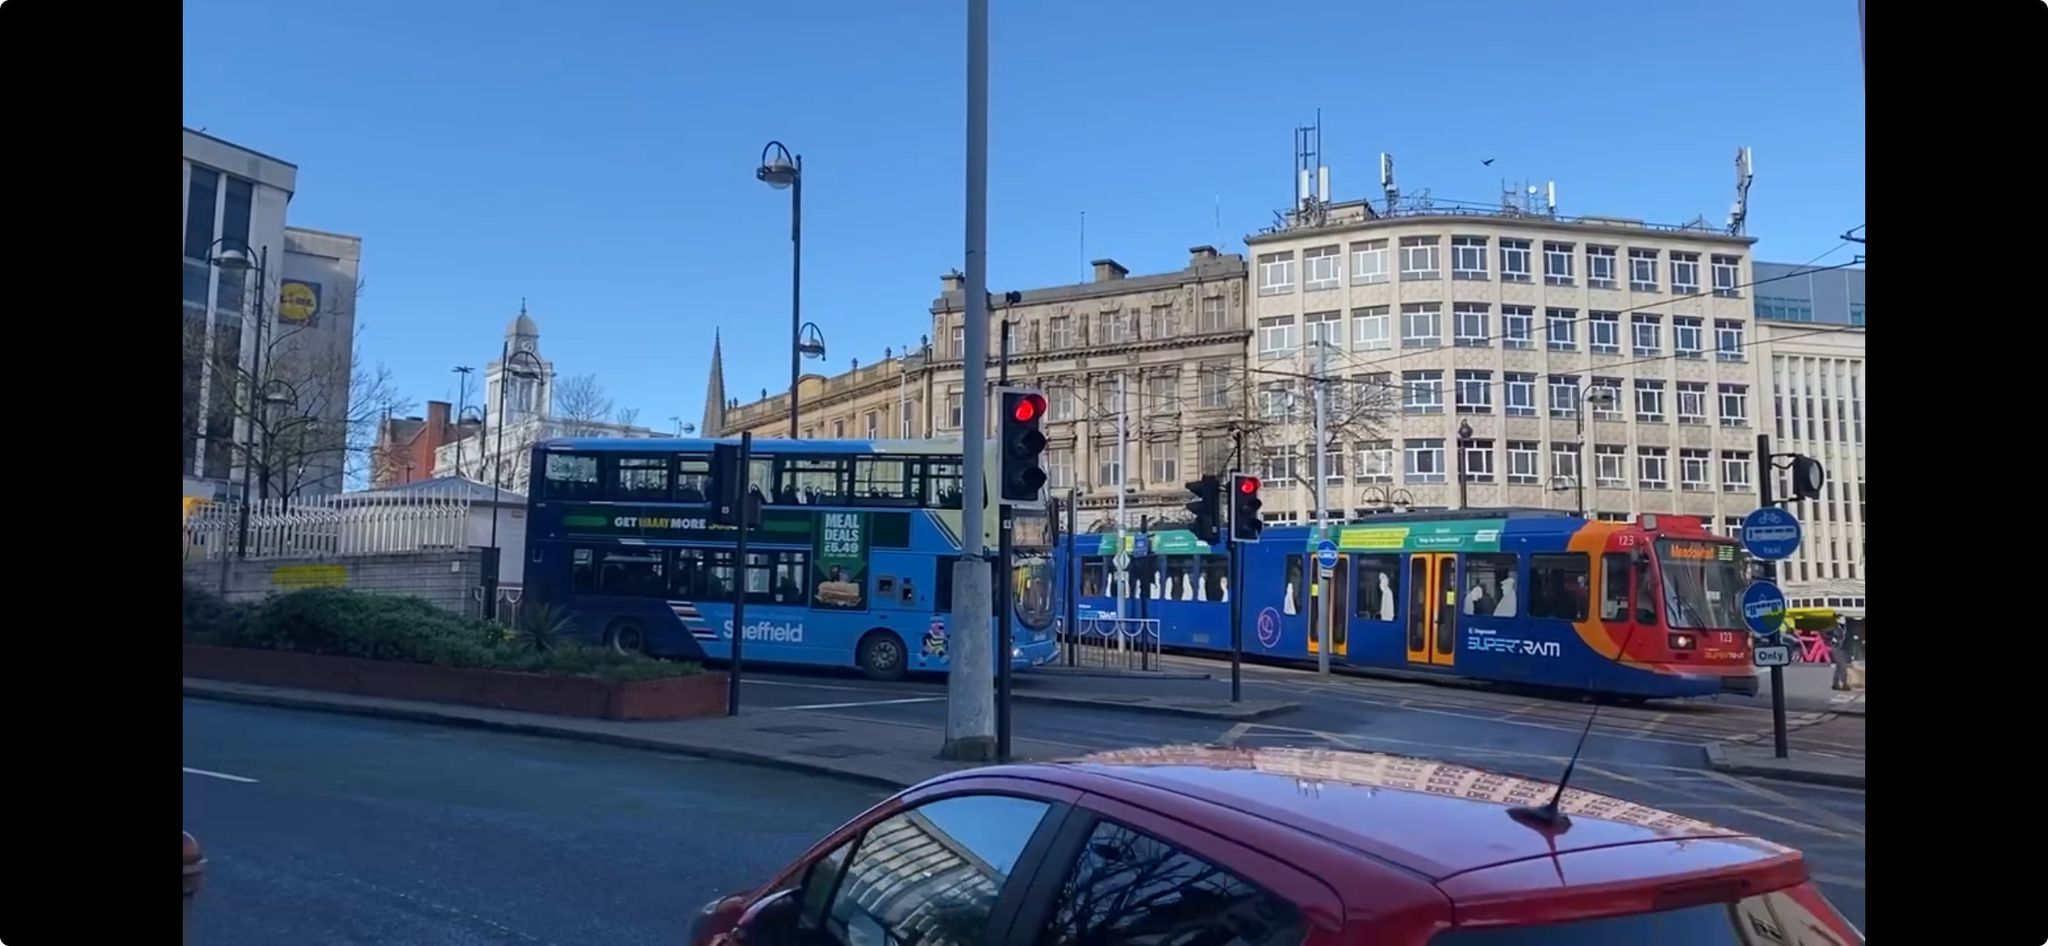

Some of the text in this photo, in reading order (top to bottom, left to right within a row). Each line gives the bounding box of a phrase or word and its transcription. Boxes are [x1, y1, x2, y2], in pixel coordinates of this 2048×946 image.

[614, 516, 637, 527] GET
[670, 518, 706, 530] MORE
[825, 513, 860, 528] MEAL
[825, 529, 859, 541] DEALS
[1619, 535, 1635, 546] 123
[1763, 546, 1782, 555] taxi
[1720, 631, 1733, 643] 123
[1758, 649, 1784, 662] Only
